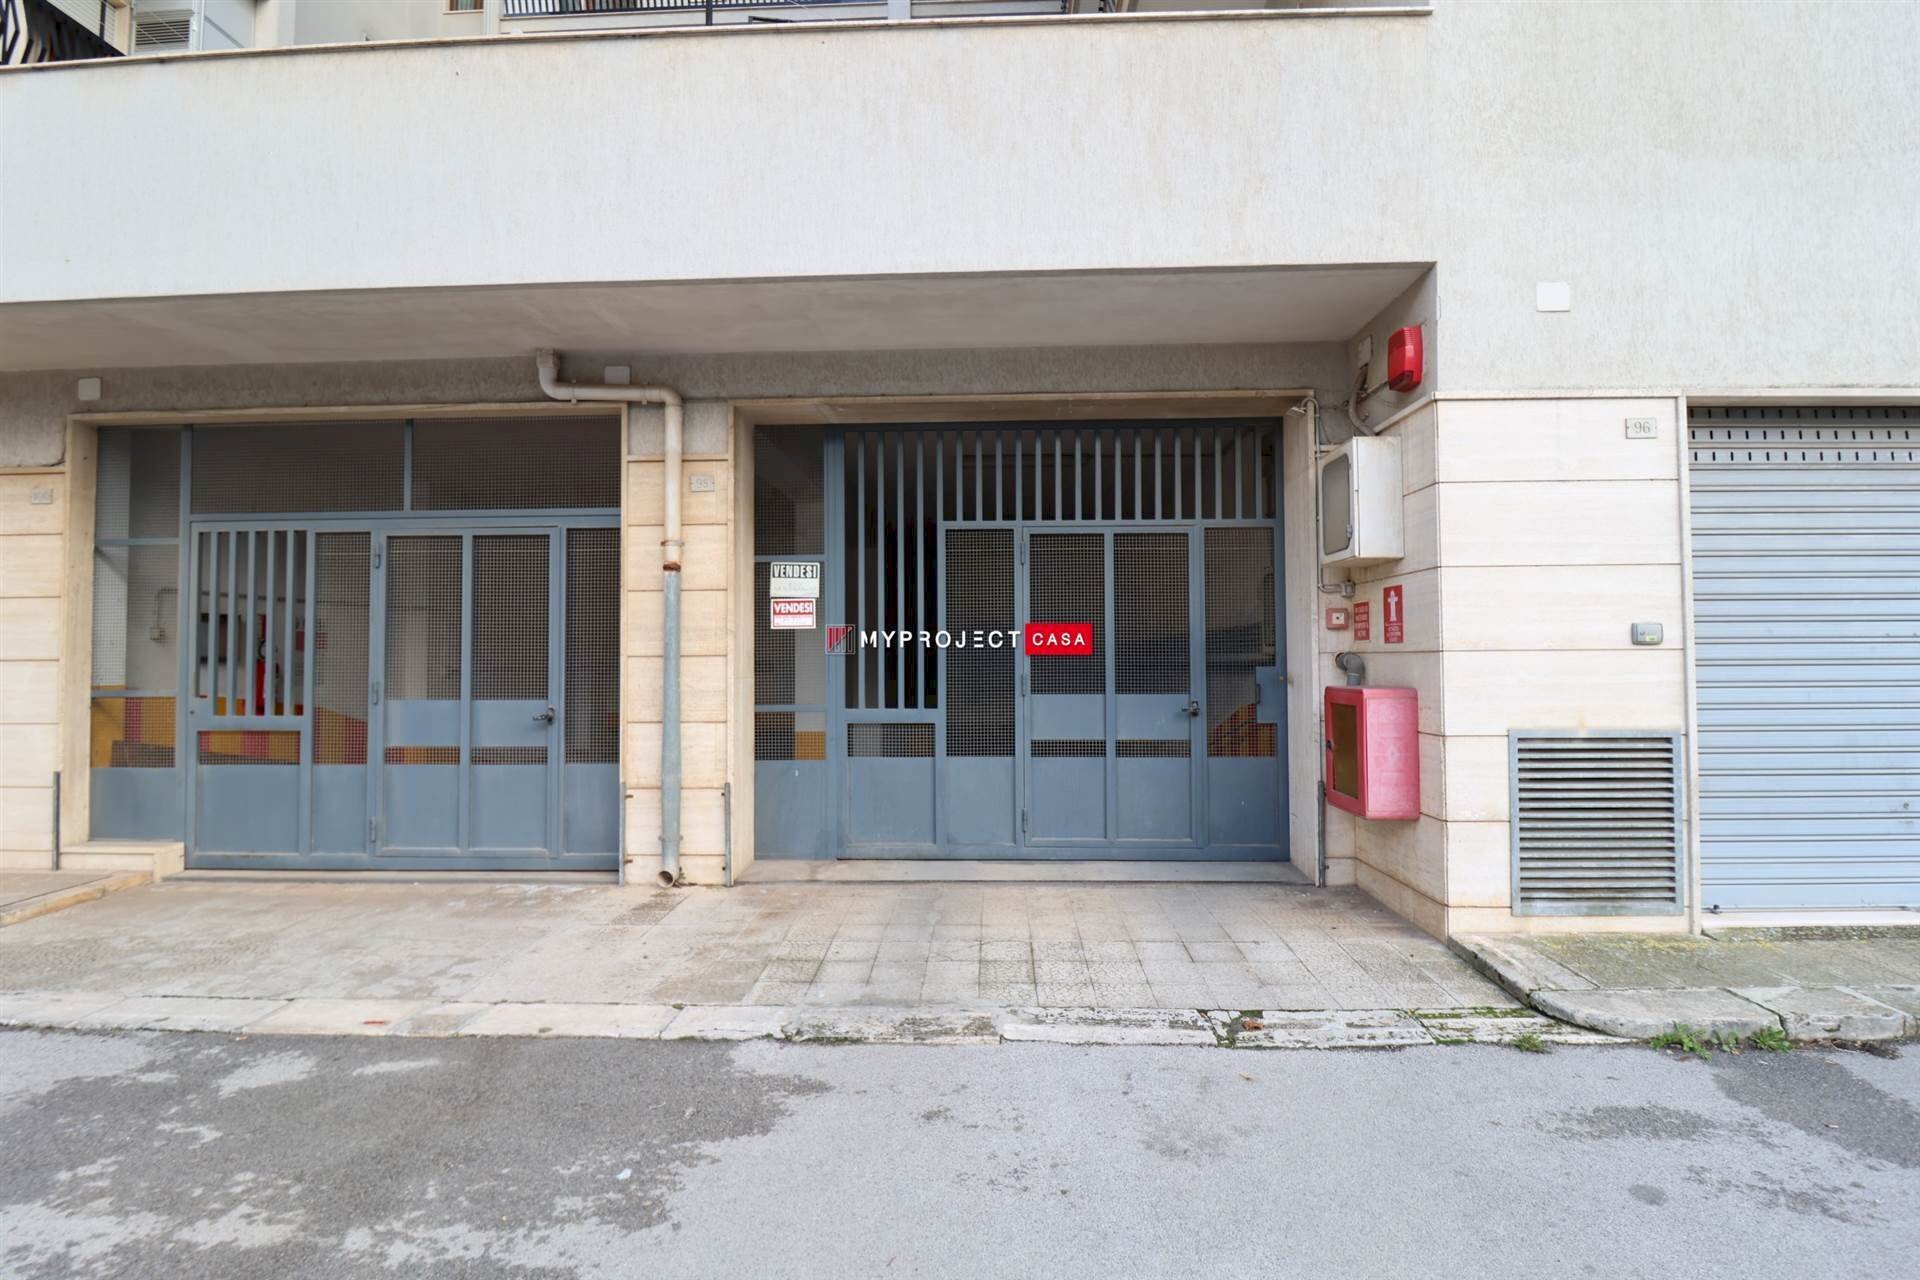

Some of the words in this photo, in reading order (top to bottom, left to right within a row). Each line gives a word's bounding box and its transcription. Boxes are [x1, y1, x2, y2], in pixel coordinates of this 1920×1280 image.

[1633, 420, 1651, 434] 96
[773, 564, 817, 578] VENDESI
[773, 602, 813, 614] VENDESI
